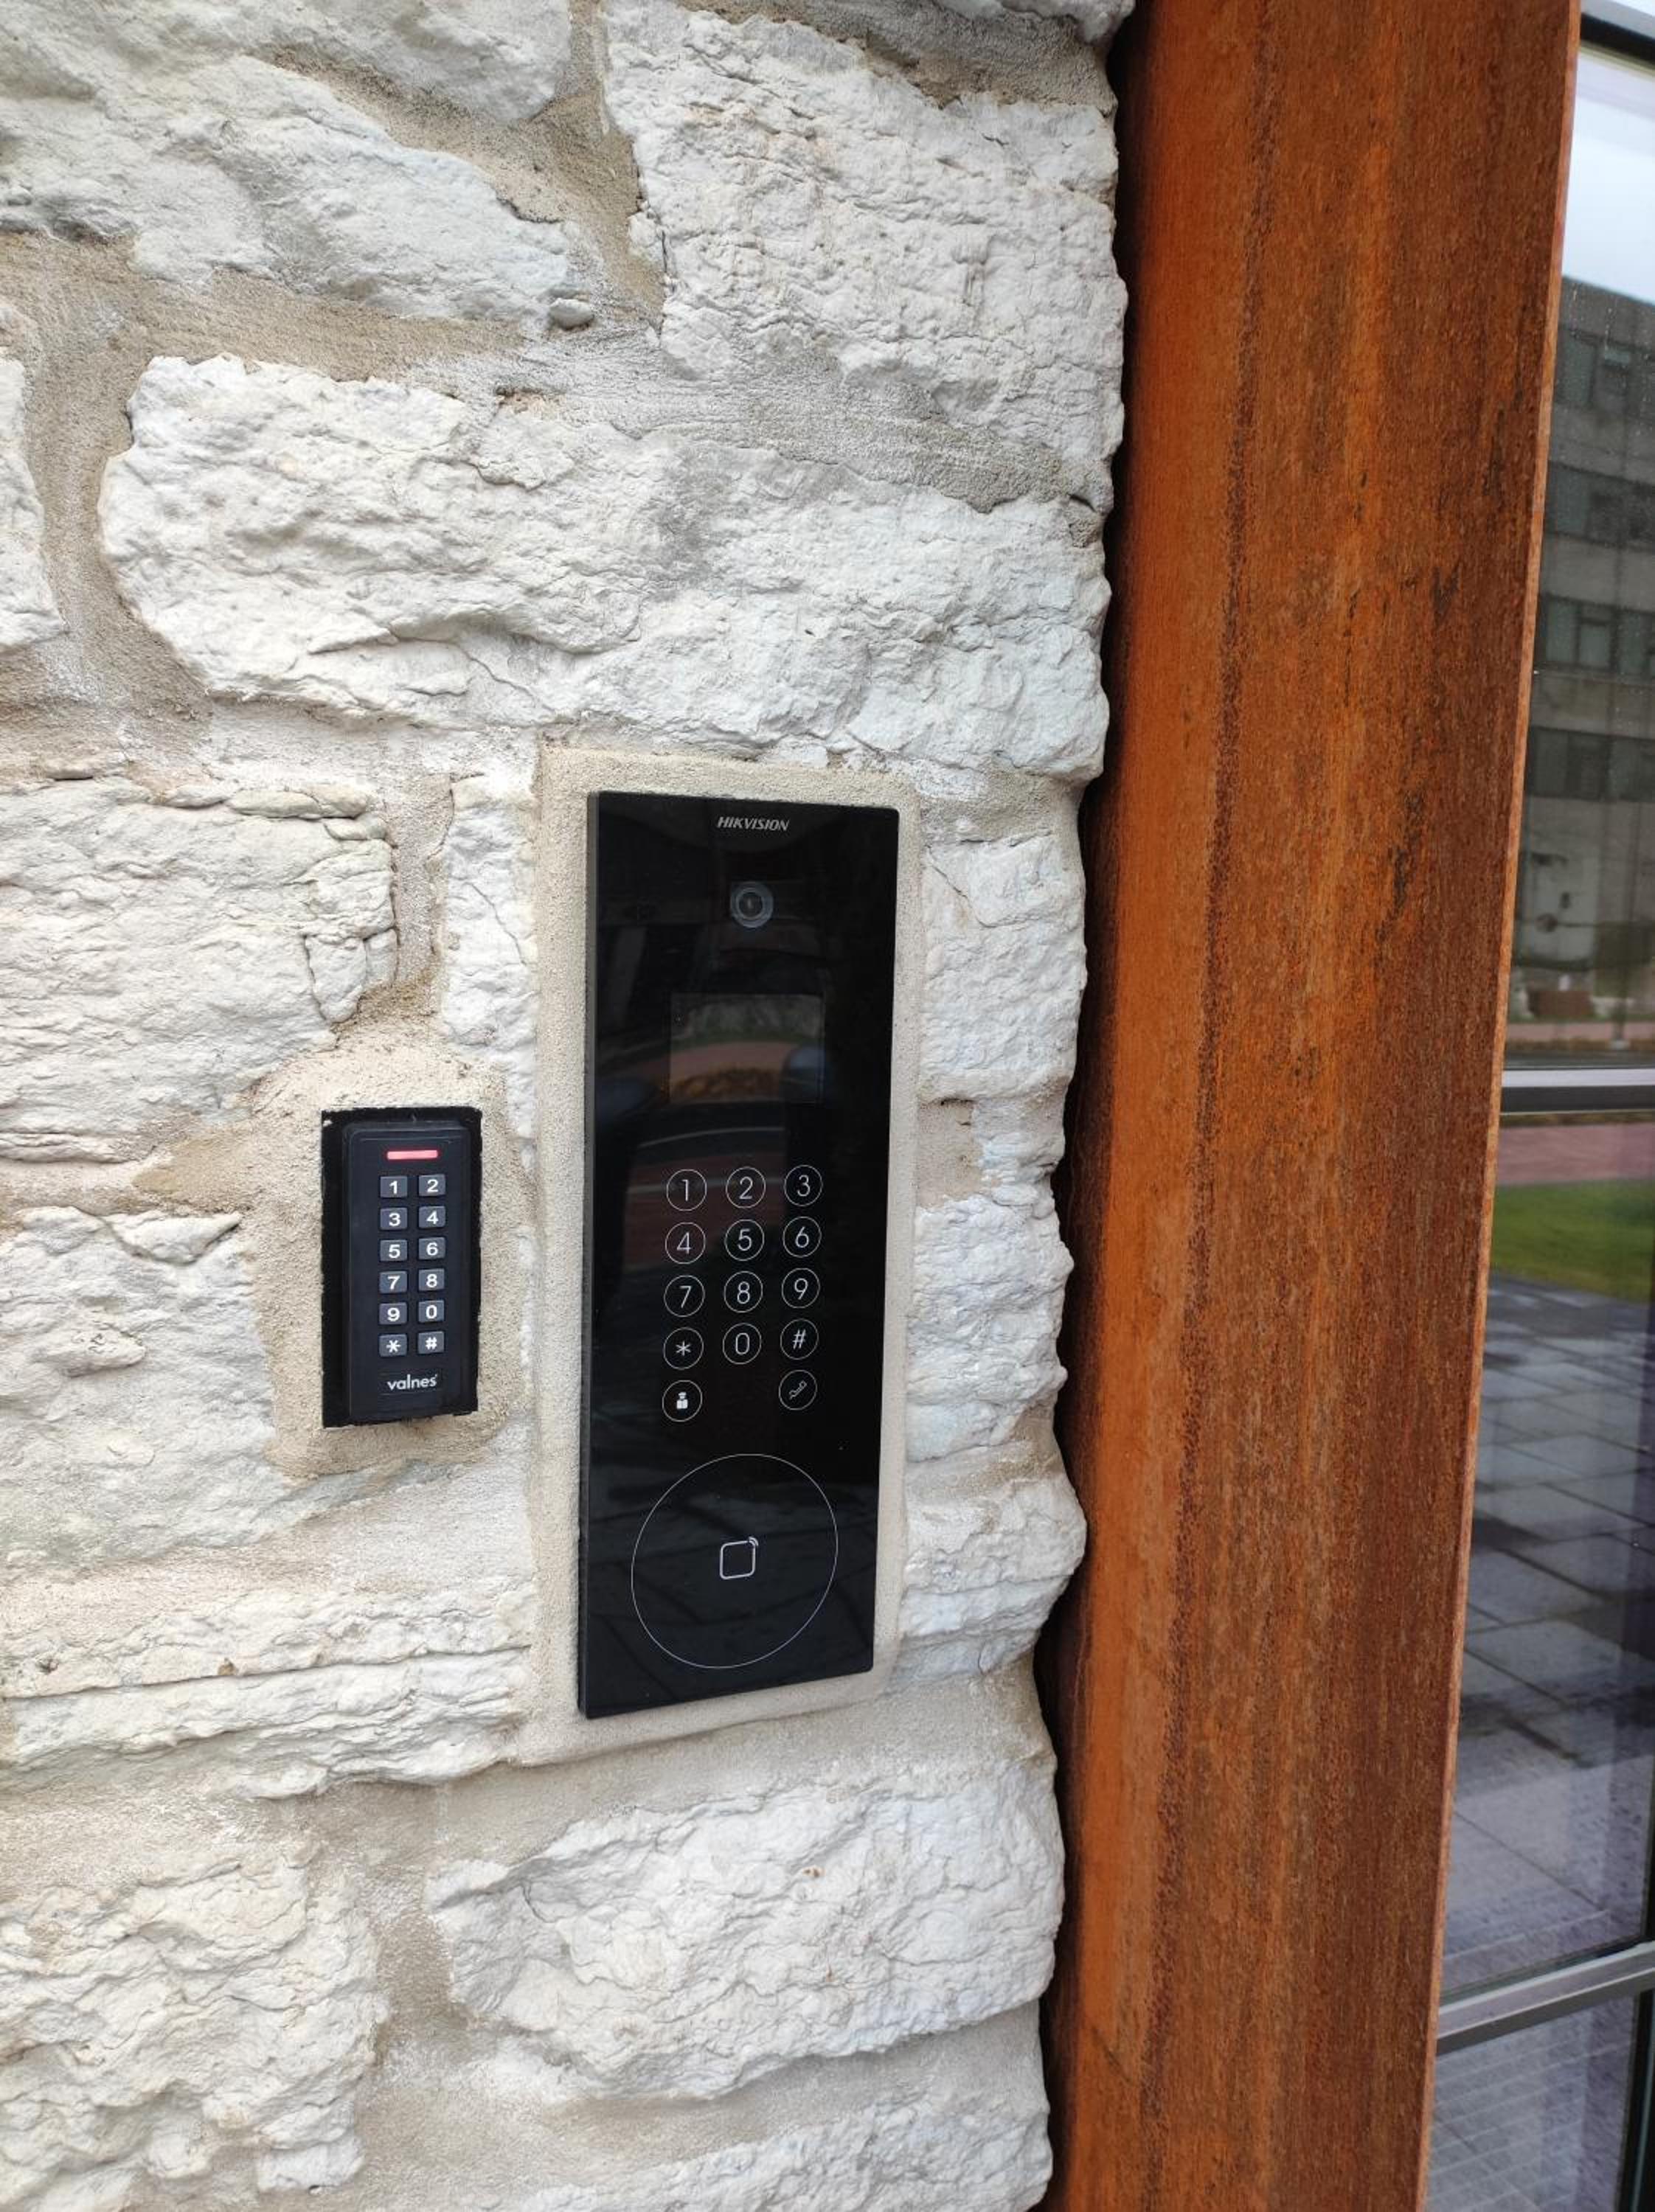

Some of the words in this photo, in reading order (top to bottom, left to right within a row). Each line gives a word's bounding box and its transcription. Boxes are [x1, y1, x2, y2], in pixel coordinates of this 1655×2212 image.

[717, 816, 789, 831] HIKVISION
[427, 1178, 439, 1193] 2
[739, 1176, 753, 1200] 2
[797, 1175, 811, 1197] 3
[389, 1212, 401, 1227] 3
[426, 1211, 439, 1225] 4
[676, 1232, 691, 1254] 4
[738, 1228, 752, 1251] 5
[795, 1226, 810, 1248] 6
[389, 1244, 400, 1259] 5
[426, 1242, 439, 1256] 6
[387, 1275, 400, 1290] 7
[426, 1273, 438, 1288] 8
[680, 1285, 692, 1308] 7
[737, 1281, 751, 1304] 8
[794, 1278, 808, 1300] 9
[387, 1307, 400, 1322] 9
[426, 1304, 437, 1319] 0
[735, 1332, 750, 1355] 0
[386, 1374, 437, 1391] valnes
